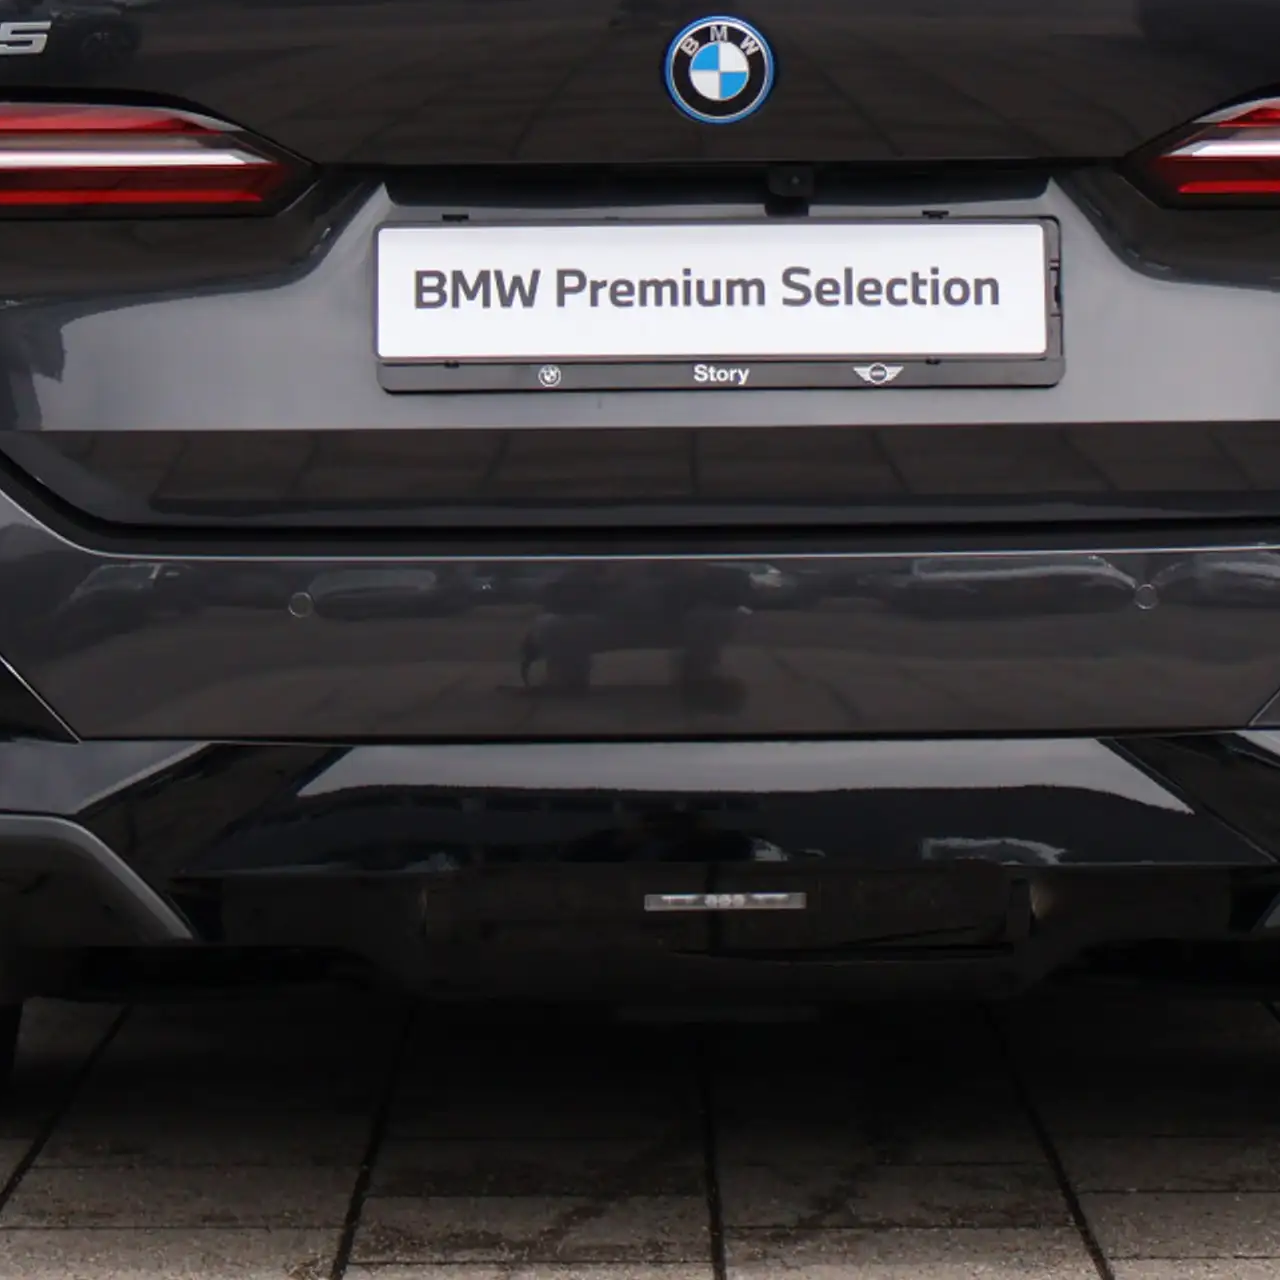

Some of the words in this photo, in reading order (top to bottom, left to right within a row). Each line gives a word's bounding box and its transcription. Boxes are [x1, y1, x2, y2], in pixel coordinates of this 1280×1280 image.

[413, 269, 541, 309] BMW
[557, 268, 766, 308] Premium
[782, 266, 1000, 307] Selection
[694, 364, 750, 385] Story
